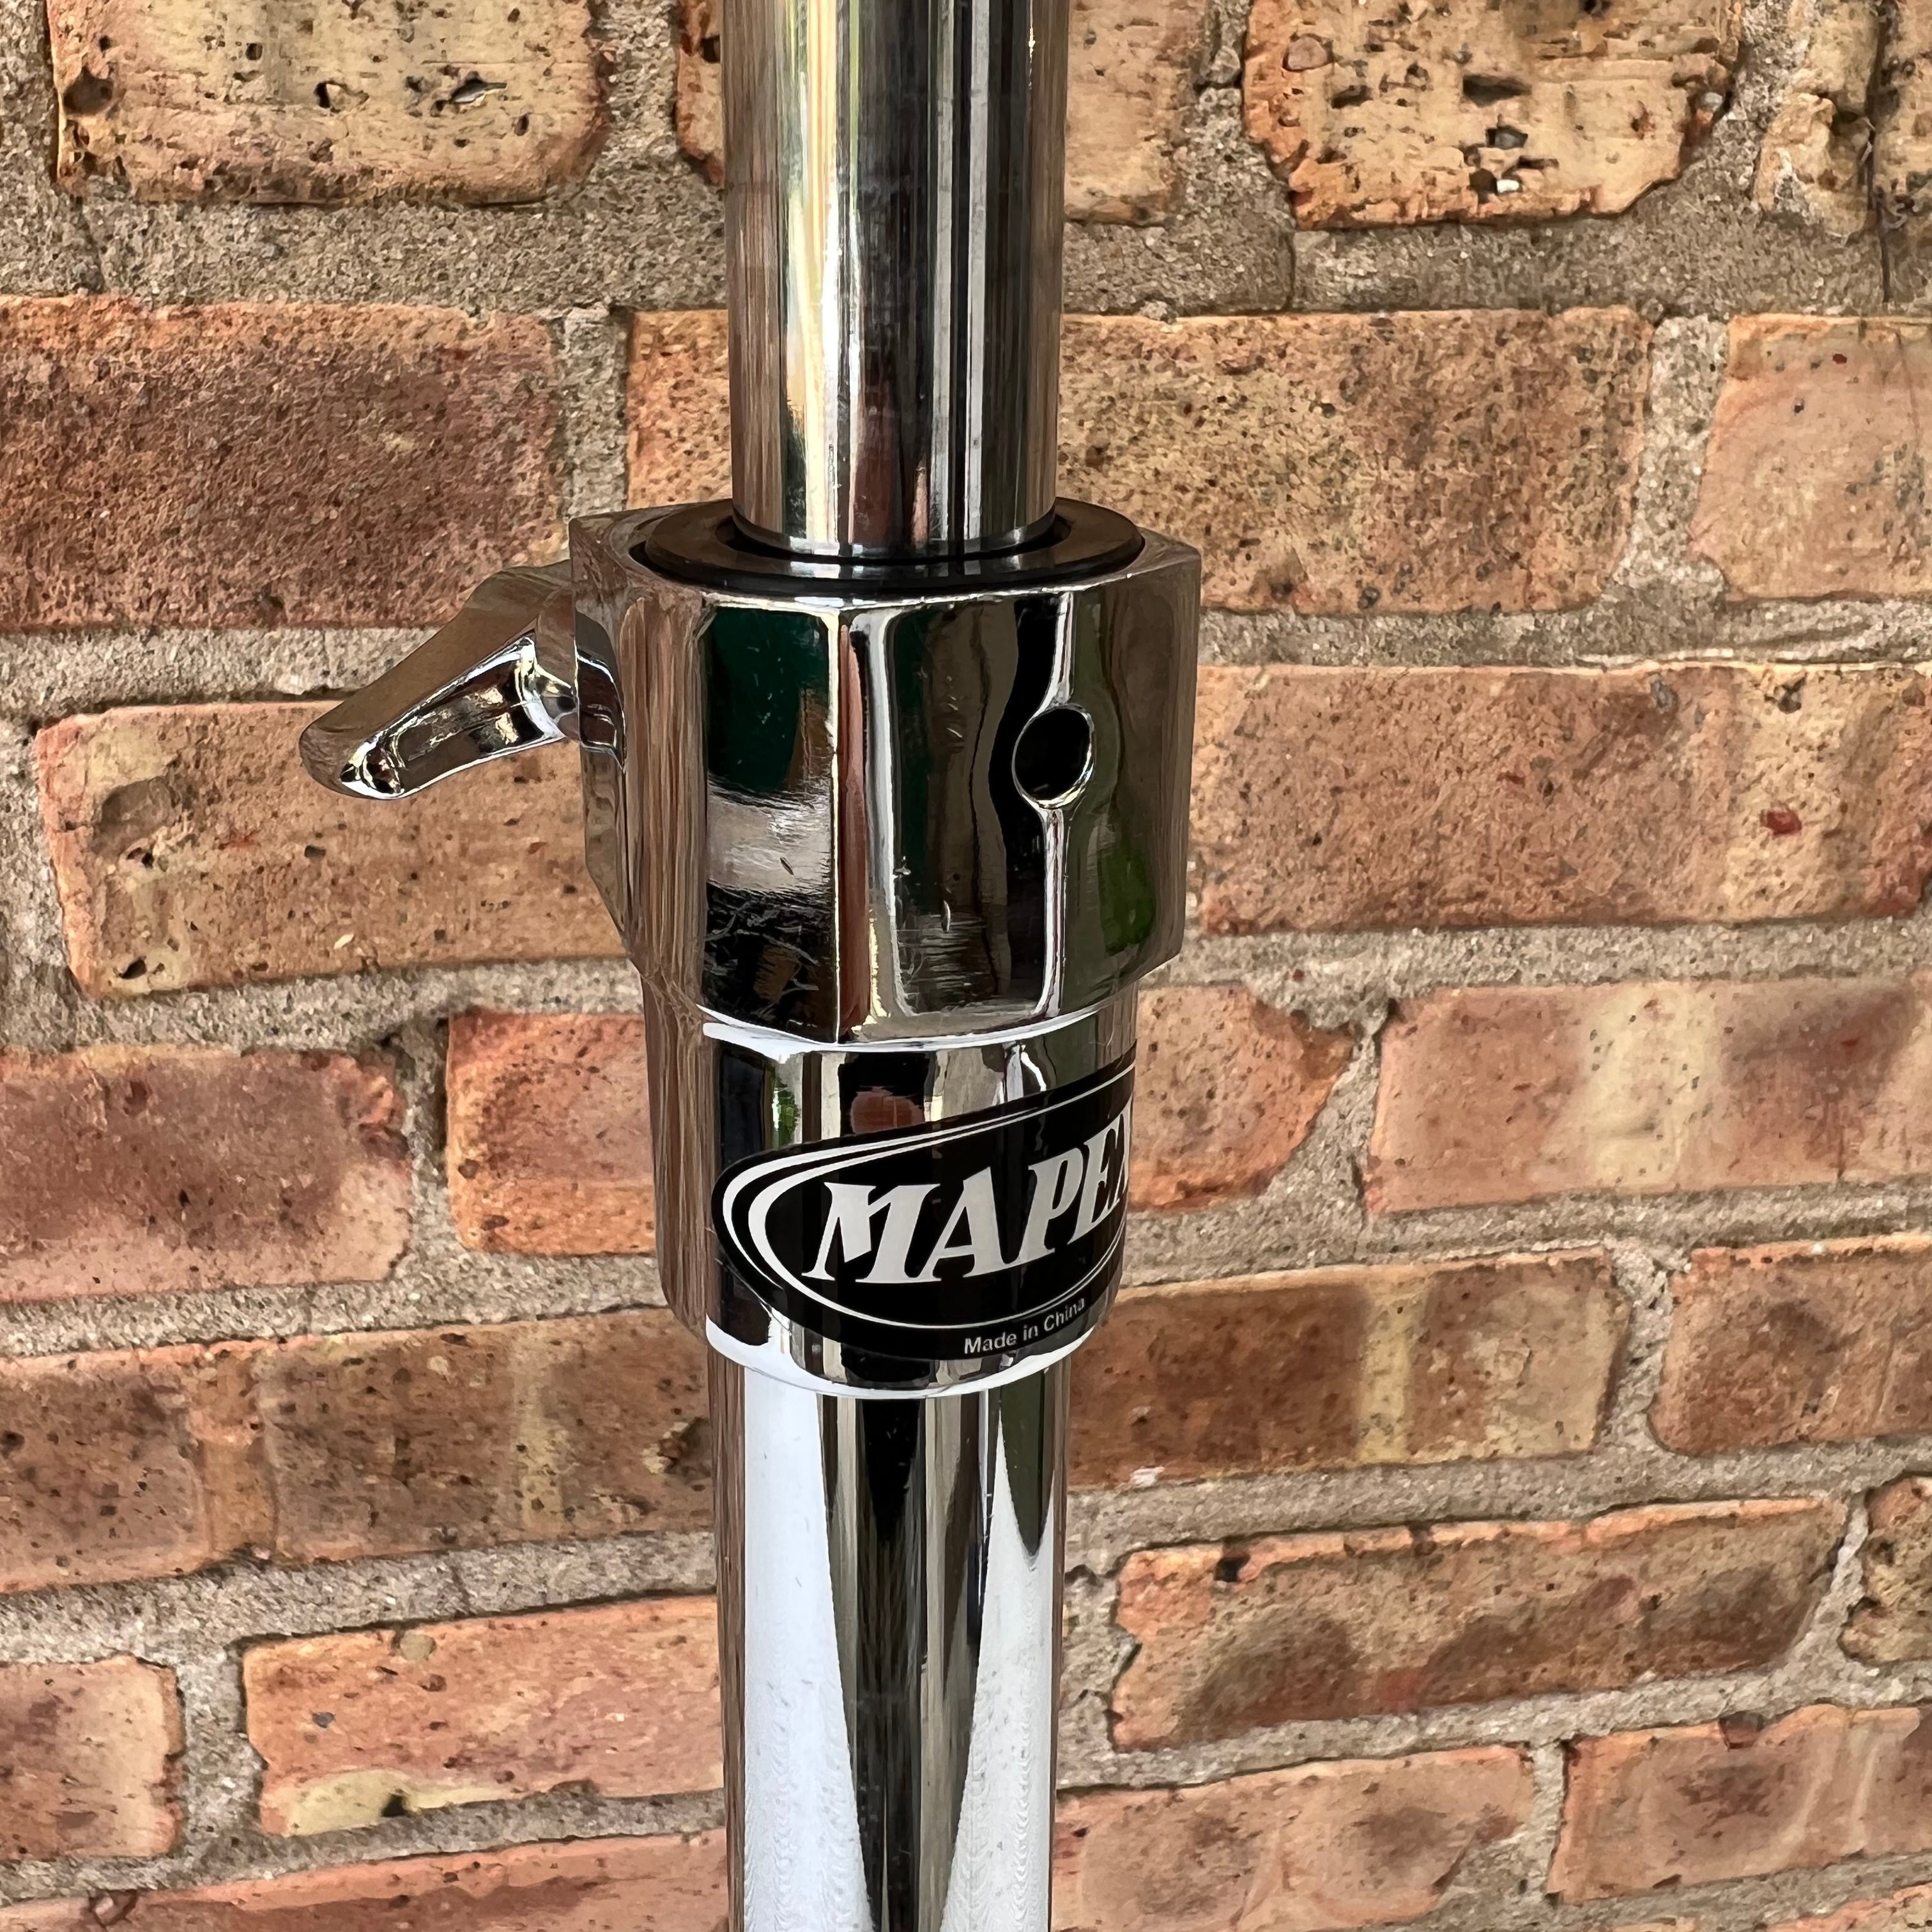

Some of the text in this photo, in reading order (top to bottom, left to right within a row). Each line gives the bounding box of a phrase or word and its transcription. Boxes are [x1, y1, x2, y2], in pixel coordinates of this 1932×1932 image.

[964, 1298, 1085, 1354] Made in China
